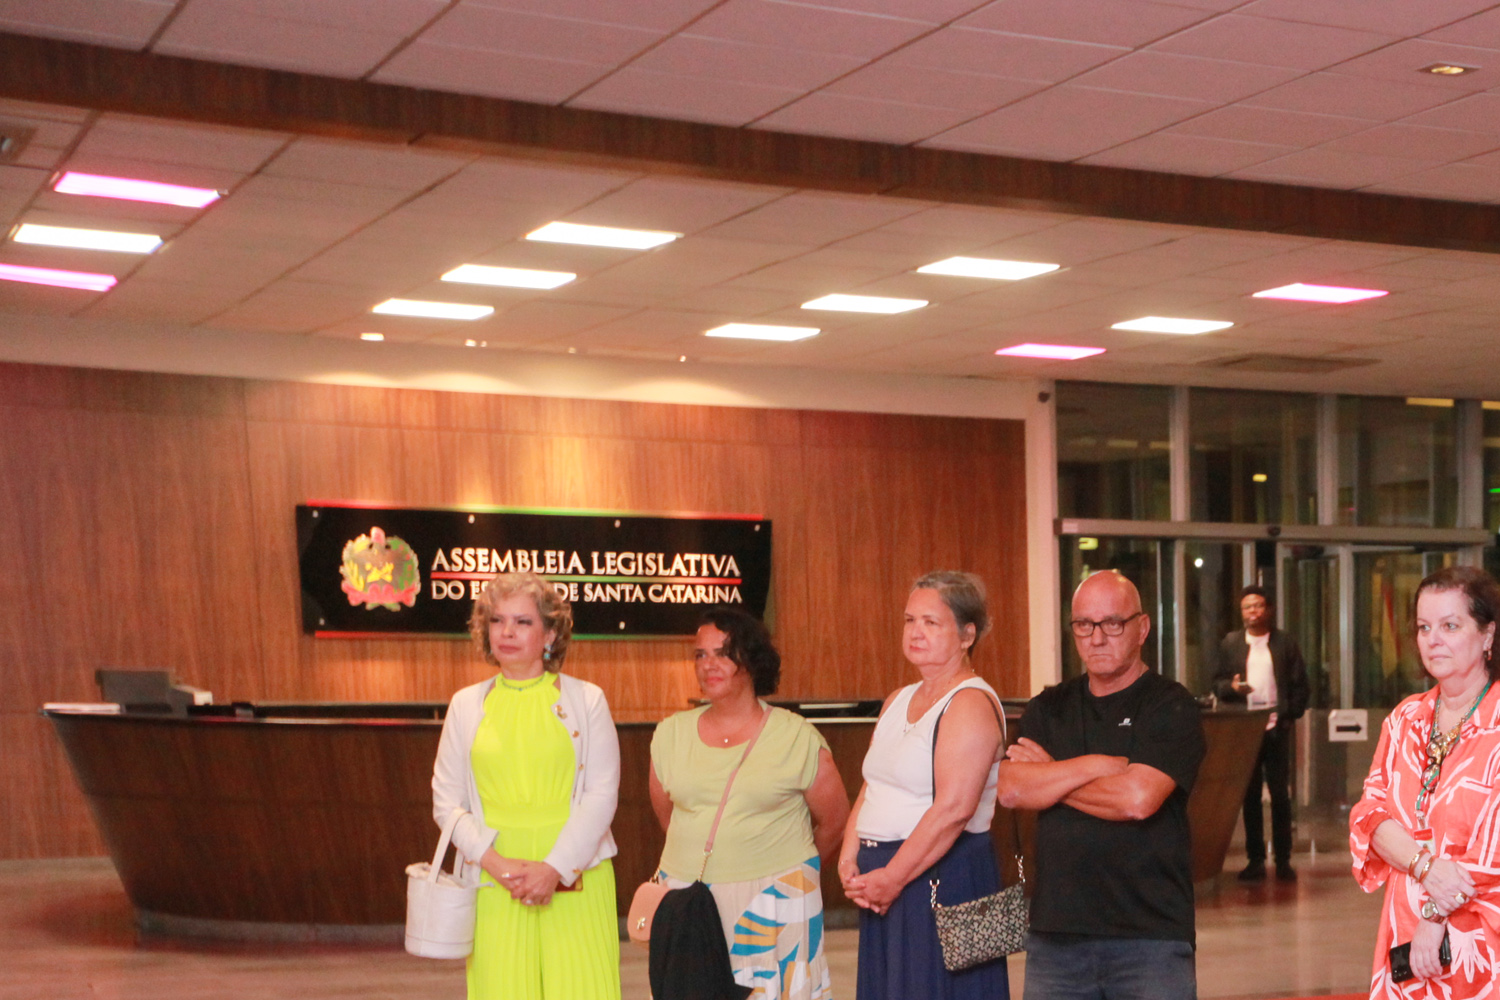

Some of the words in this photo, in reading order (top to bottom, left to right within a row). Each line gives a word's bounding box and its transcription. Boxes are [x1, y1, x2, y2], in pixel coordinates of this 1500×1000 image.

[431, 547, 586, 575] ASSEMBLEIA
[591, 551, 741, 577] LEGISLATIVA
[431, 580, 465, 600] DO
[554, 582, 579, 602] DE
[583, 582, 646, 603] SANTA
[648, 584, 743, 604] CATARINA
